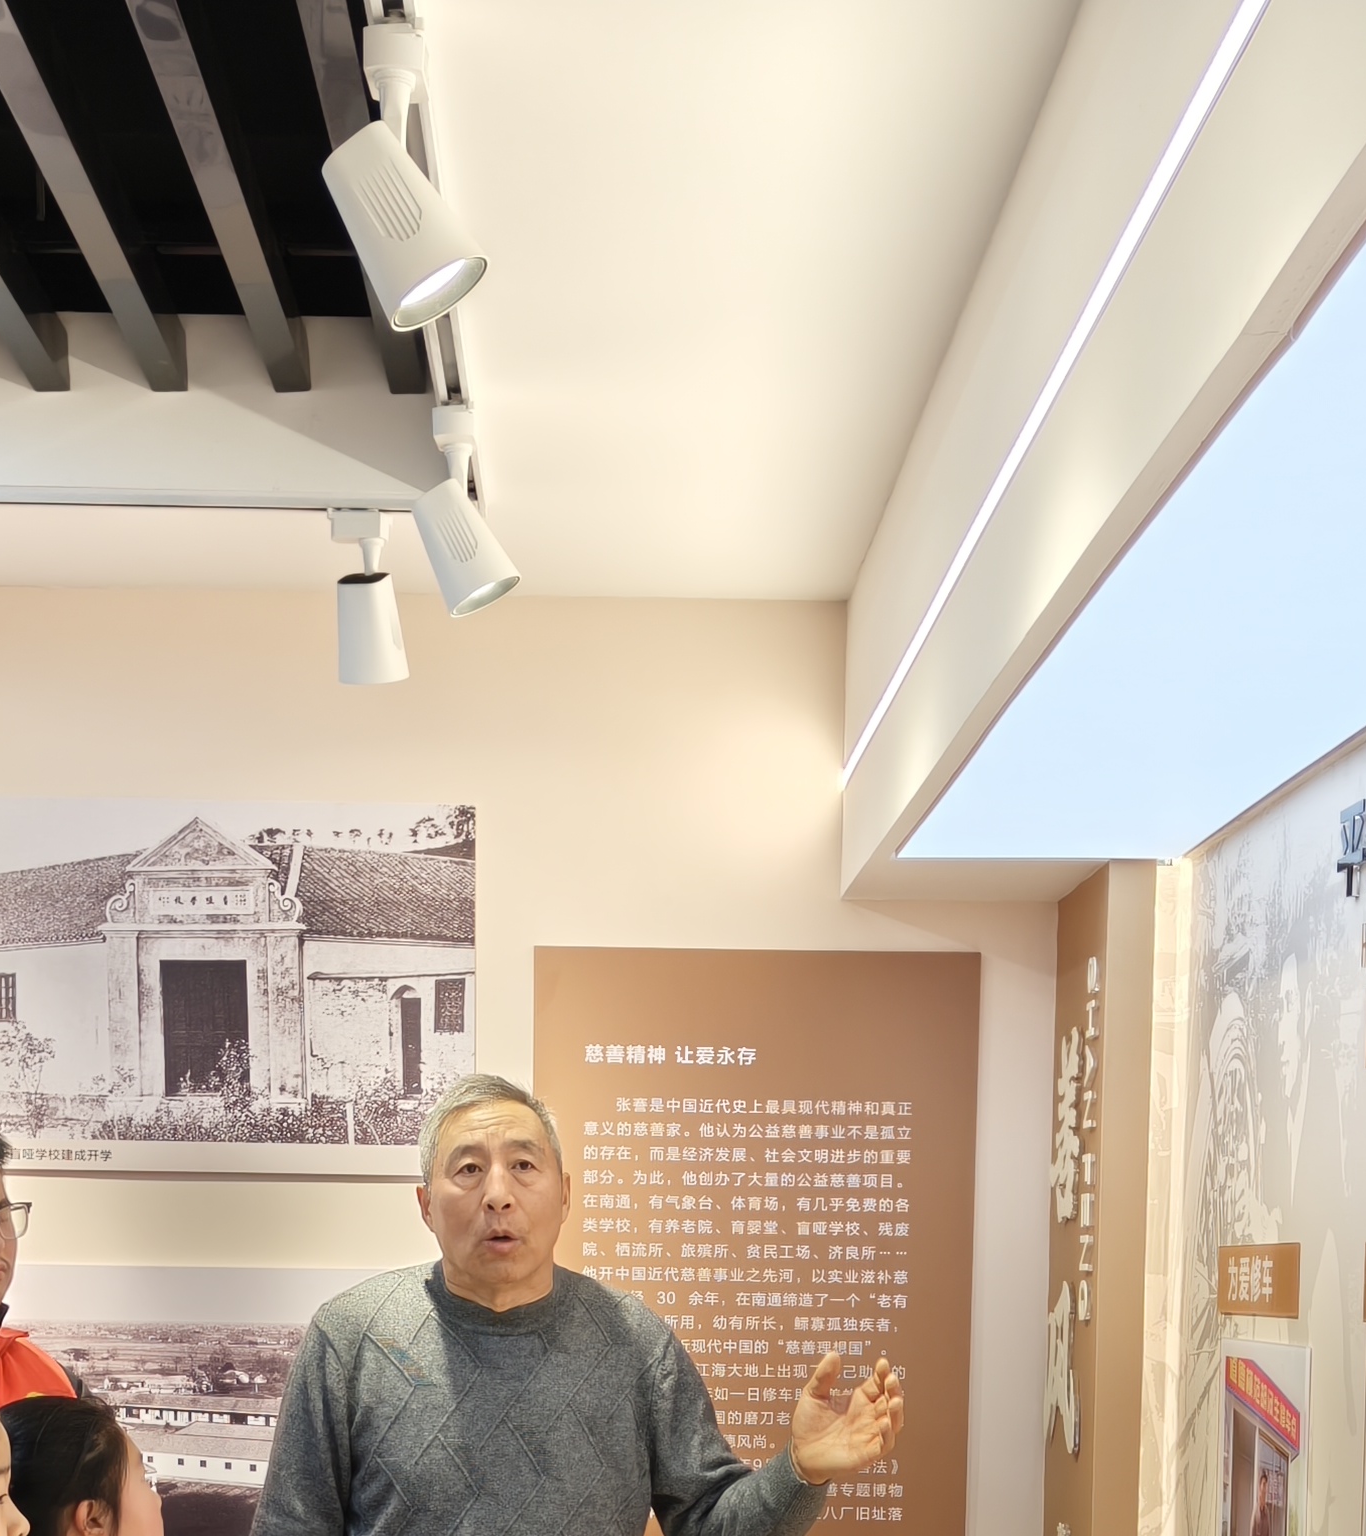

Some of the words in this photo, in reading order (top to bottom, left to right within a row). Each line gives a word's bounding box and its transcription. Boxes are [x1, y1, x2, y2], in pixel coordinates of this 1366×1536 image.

[585, 1043, 666, 1064] 慈善精神
[674, 1045, 757, 1066] 让爱永存
[616, 1097, 913, 1117] 张謇是中国近代史上最具现代精神和真正
[583, 1121, 912, 1140] 意义的慈善家。他认为公益慈善事业不是孤立
[583, 1145, 912, 1165] 的存在，而是经济发展、社会文明进步的重要
[583, 1169, 905, 1189] 部分。为此，他创办了大量的公益慈善项目。
[582, 1193, 911, 1213] 在南通，有气象台、体育场，有几乎免费的各
[582, 1217, 910, 1238] 类学校，有养老院、育婴堂、盲哑学校、残废
[1227, 1253, 1274, 1303] 为爱修车
[656, 1291, 676, 1305] 30
